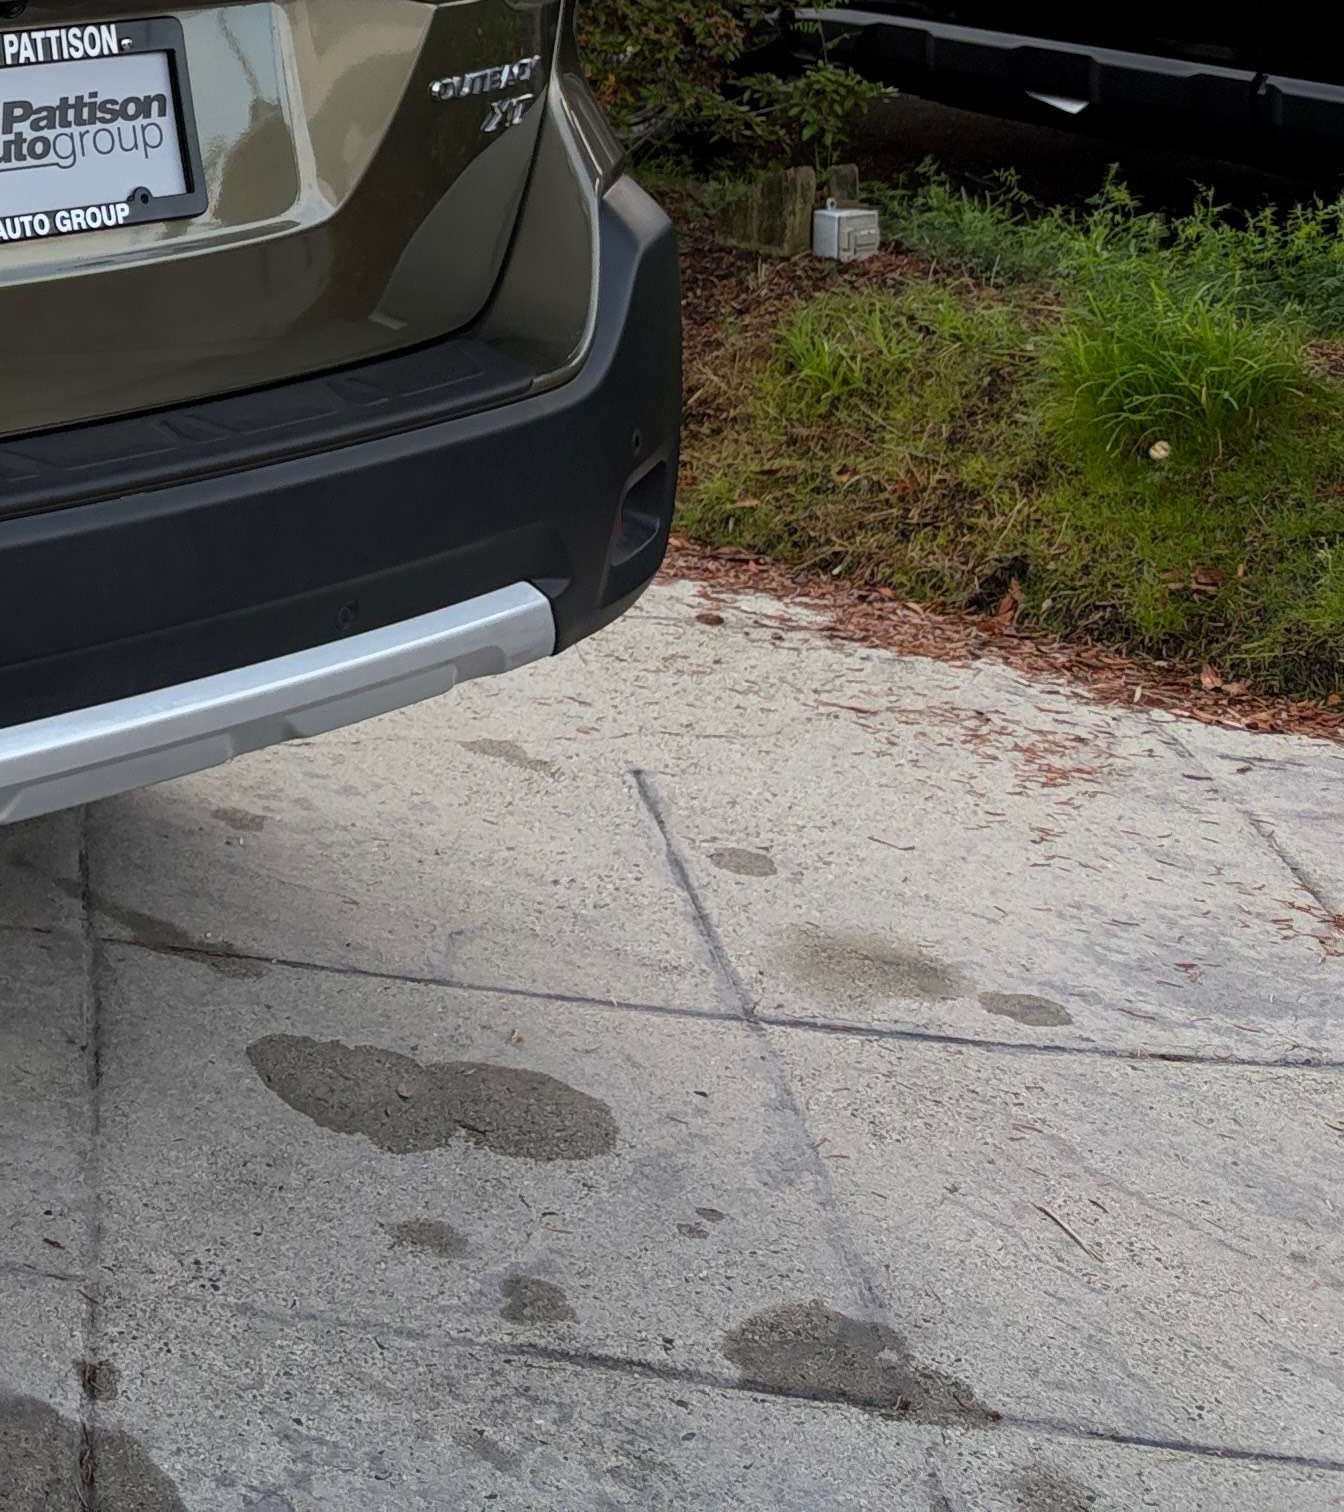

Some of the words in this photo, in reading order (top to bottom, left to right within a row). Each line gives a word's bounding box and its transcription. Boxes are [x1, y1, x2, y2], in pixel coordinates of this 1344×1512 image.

[4, 24, 119, 64] PATTISON
[2, 92, 167, 135] Pattison
[480, 93, 534, 132] XT
[55, 203, 130, 232] GROUP
